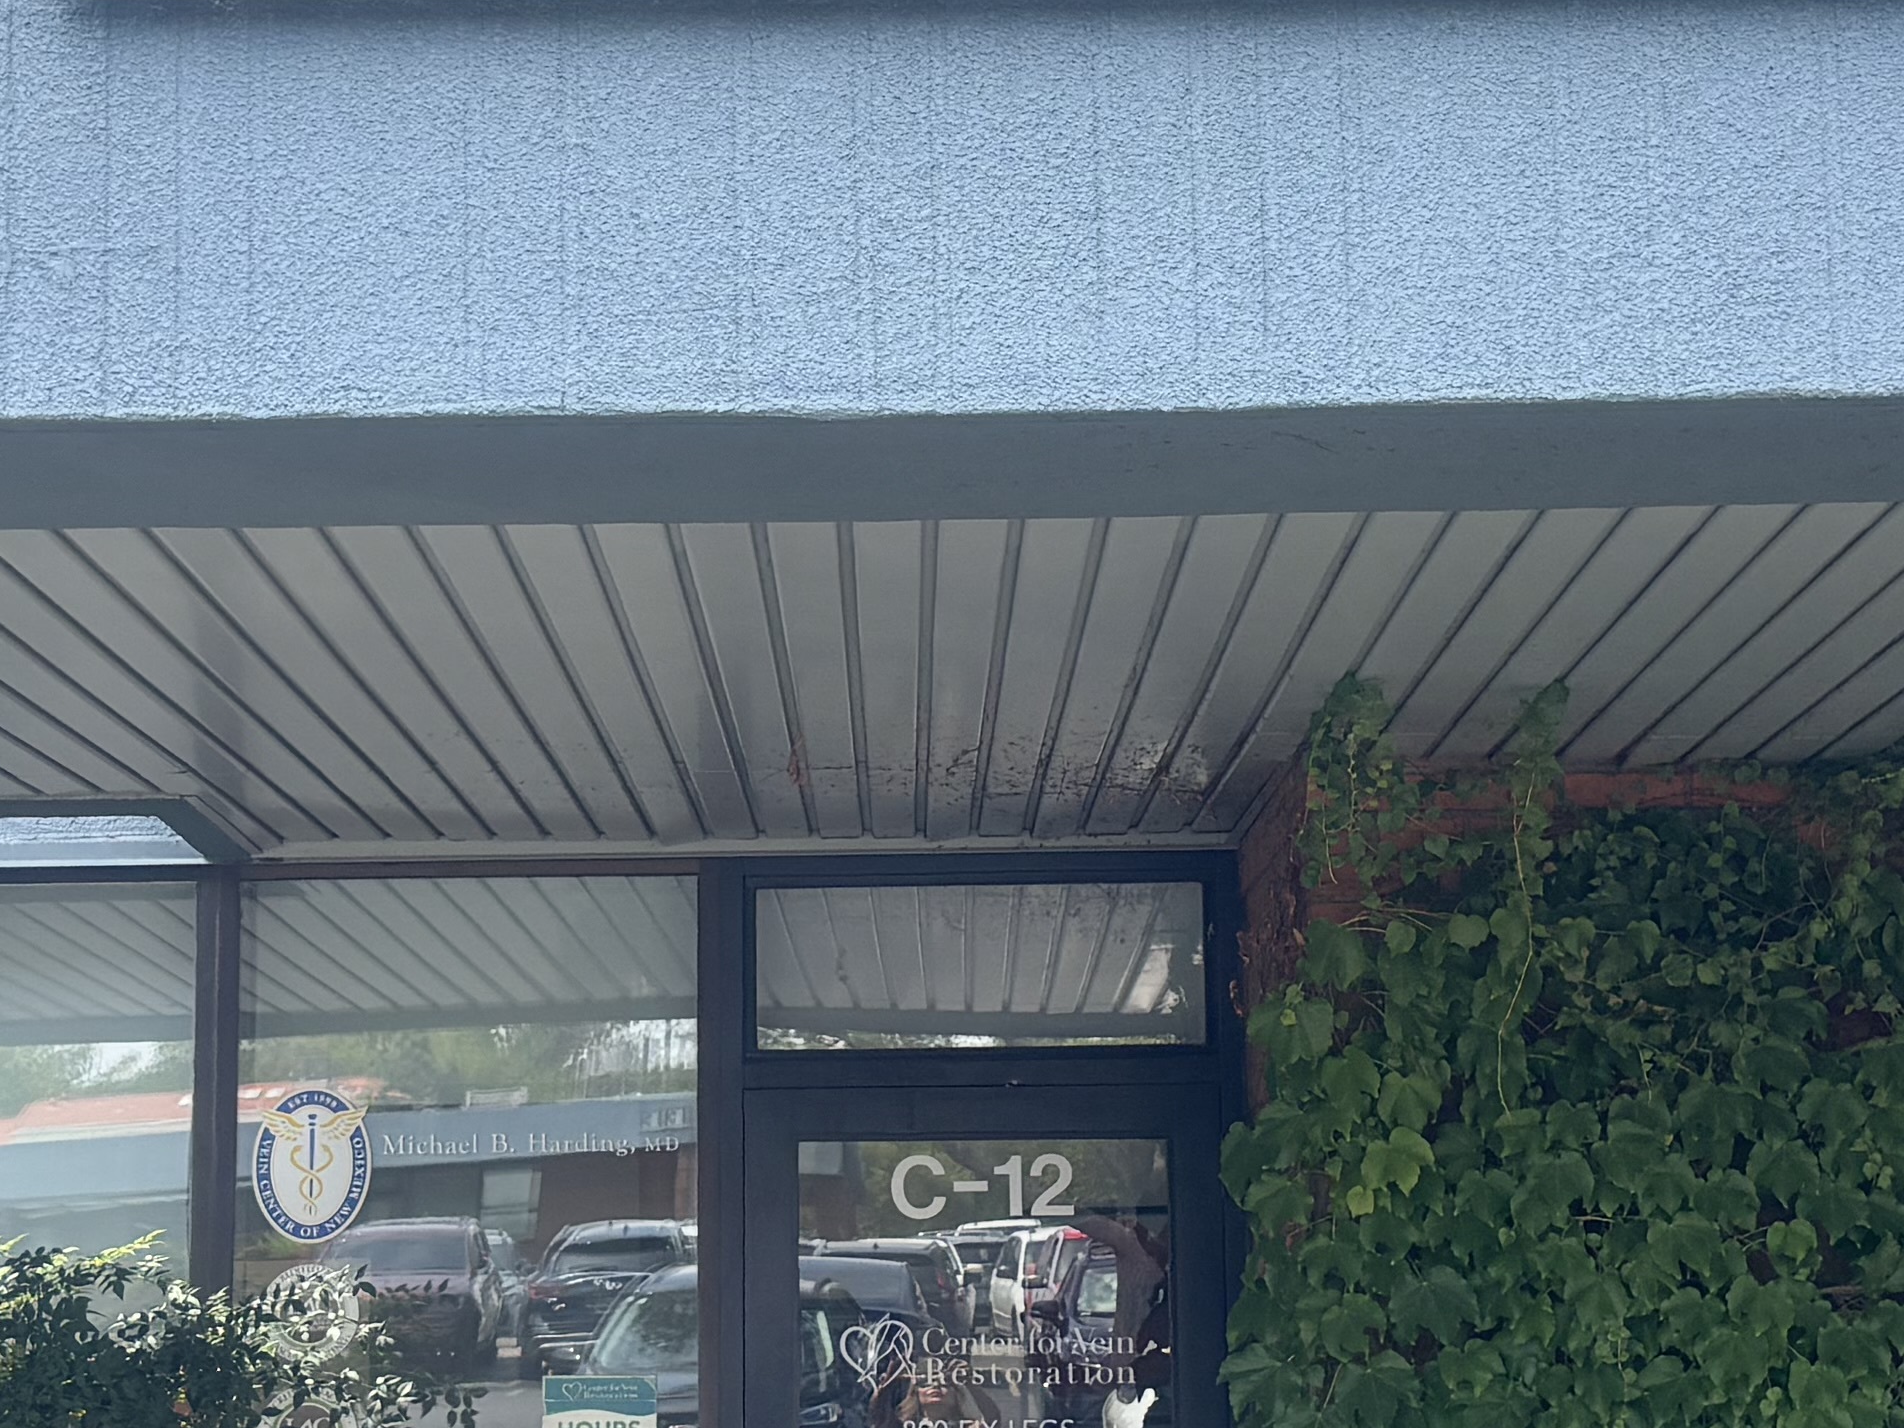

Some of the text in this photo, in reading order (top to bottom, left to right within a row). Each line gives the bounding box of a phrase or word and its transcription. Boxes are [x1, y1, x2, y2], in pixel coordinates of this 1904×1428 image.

[382, 1132, 680, 1157] Michael B. Harding, MD
[258, 1137, 365, 1237] VEIN CENTER OF NEW MEXICO
[891, 1153, 1075, 1220] C-12
[922, 1327, 1135, 1356] Center for Vein
[925, 1357, 1136, 1385] Restoration
